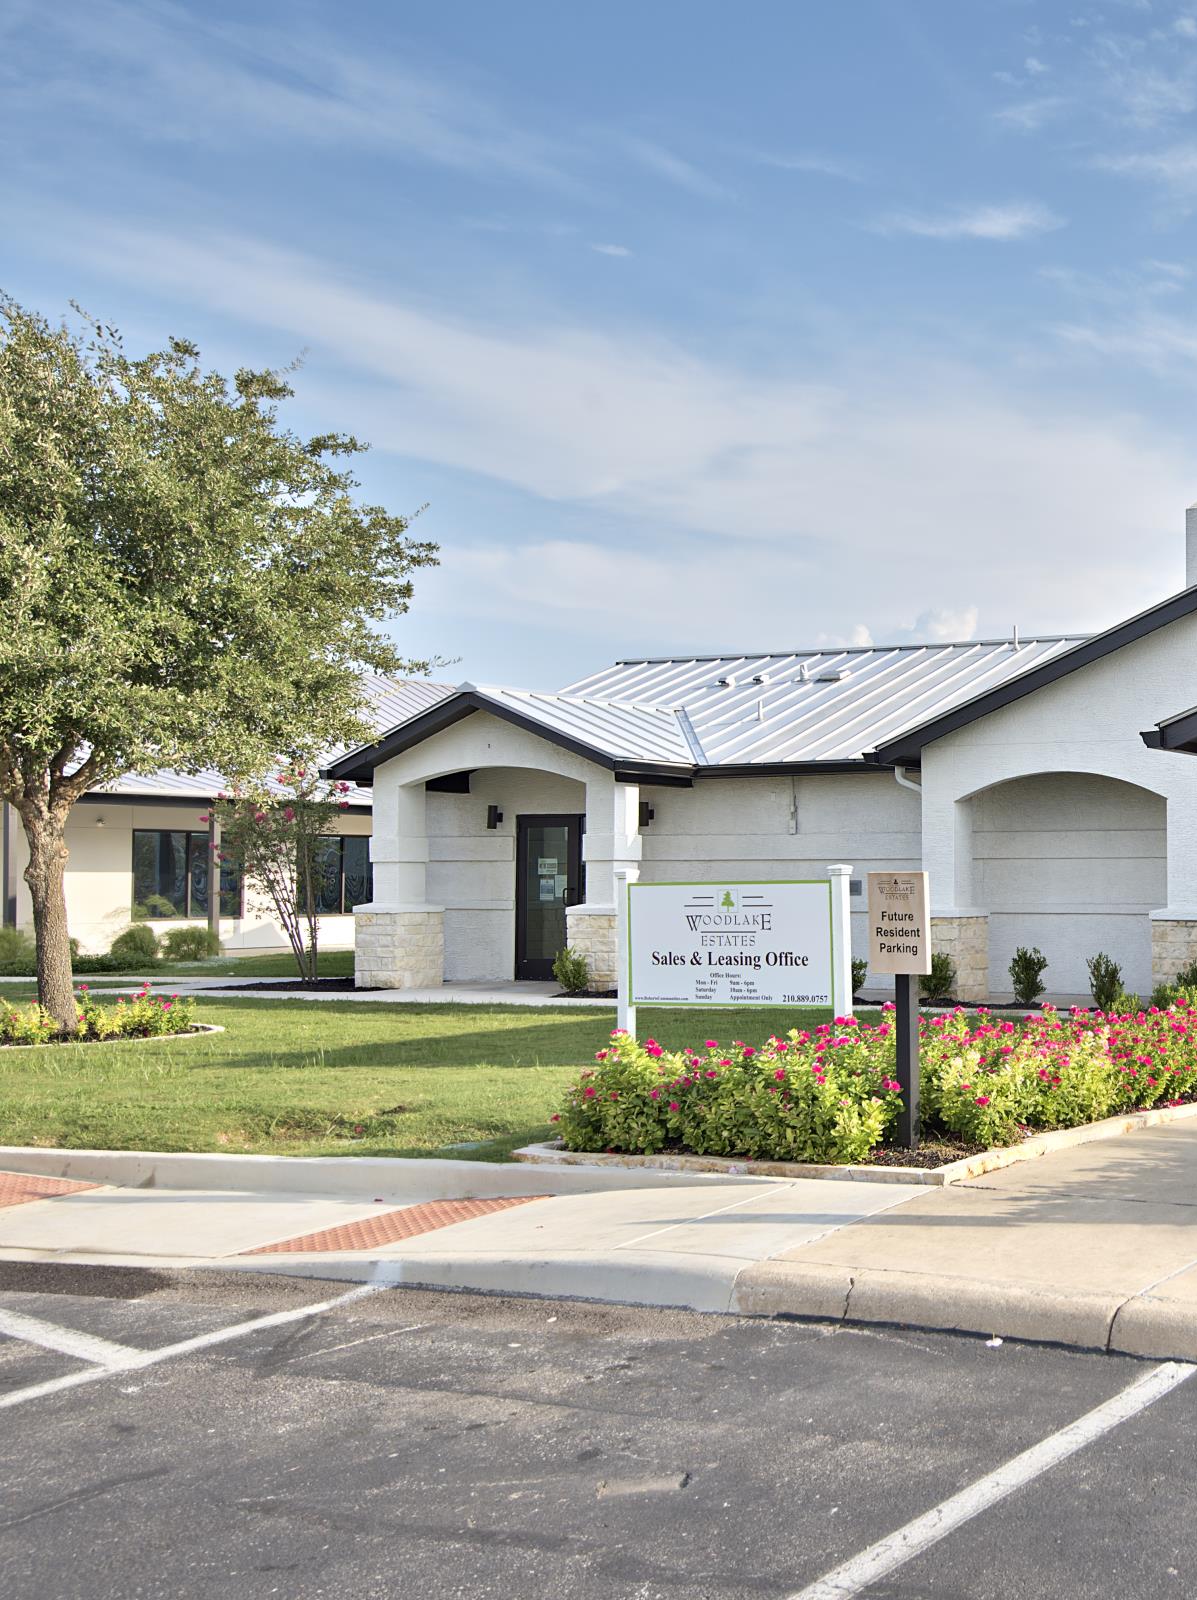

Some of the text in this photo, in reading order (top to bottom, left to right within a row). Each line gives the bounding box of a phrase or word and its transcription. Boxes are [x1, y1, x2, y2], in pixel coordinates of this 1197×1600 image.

[881, 911, 914, 921] Future
[685, 913, 772, 932] WOODLAKE
[876, 926, 921, 938] Resident
[701, 935, 756, 947] ESTATES
[879, 942, 918, 956] Parking
[651, 951, 809, 970] Sales & Leasing Office
[782, 994, 829, 1003] 210.889.0757
